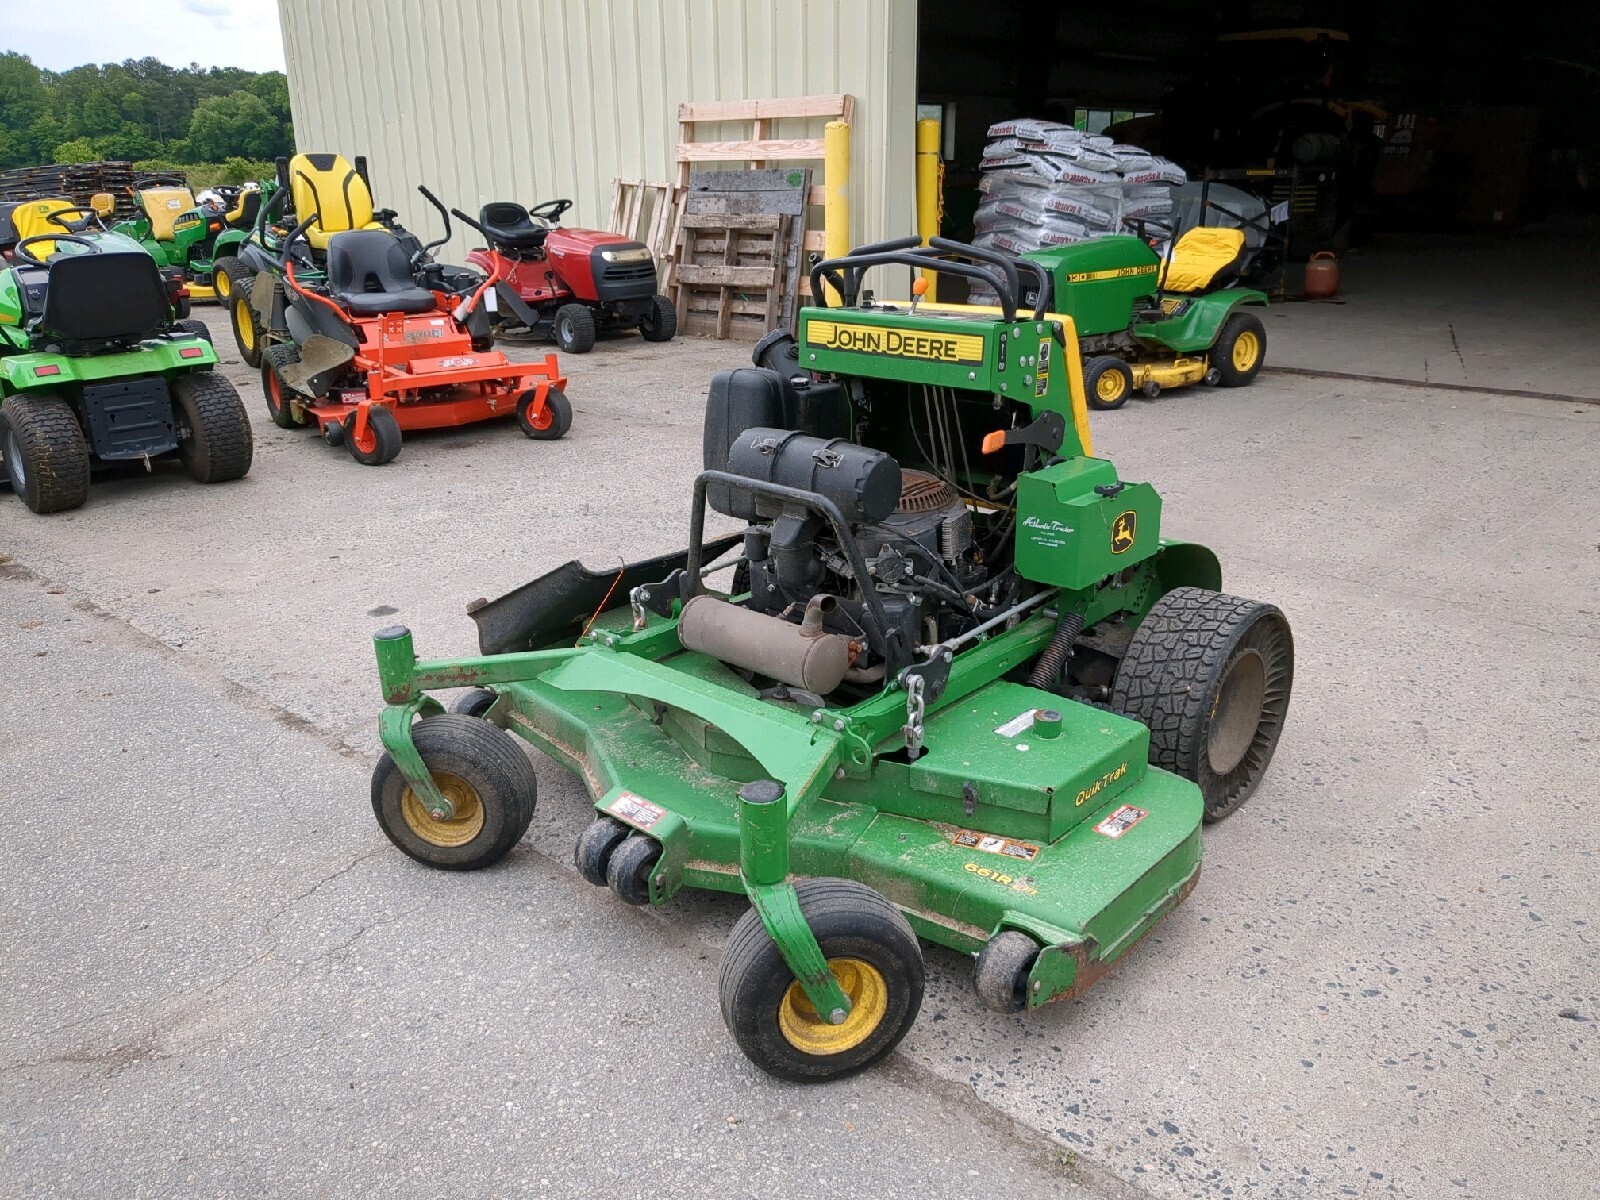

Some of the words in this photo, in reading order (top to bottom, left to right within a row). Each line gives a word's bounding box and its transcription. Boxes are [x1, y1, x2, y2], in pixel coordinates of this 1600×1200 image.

[1067, 274, 1088, 282] 130
[1117, 267, 1134, 277] JOHN
[1137, 265, 1155, 275] DEERE
[827, 325, 881, 351] JOHN
[886, 331, 957, 358] DEERE
[963, 862, 1014, 885] 661R
